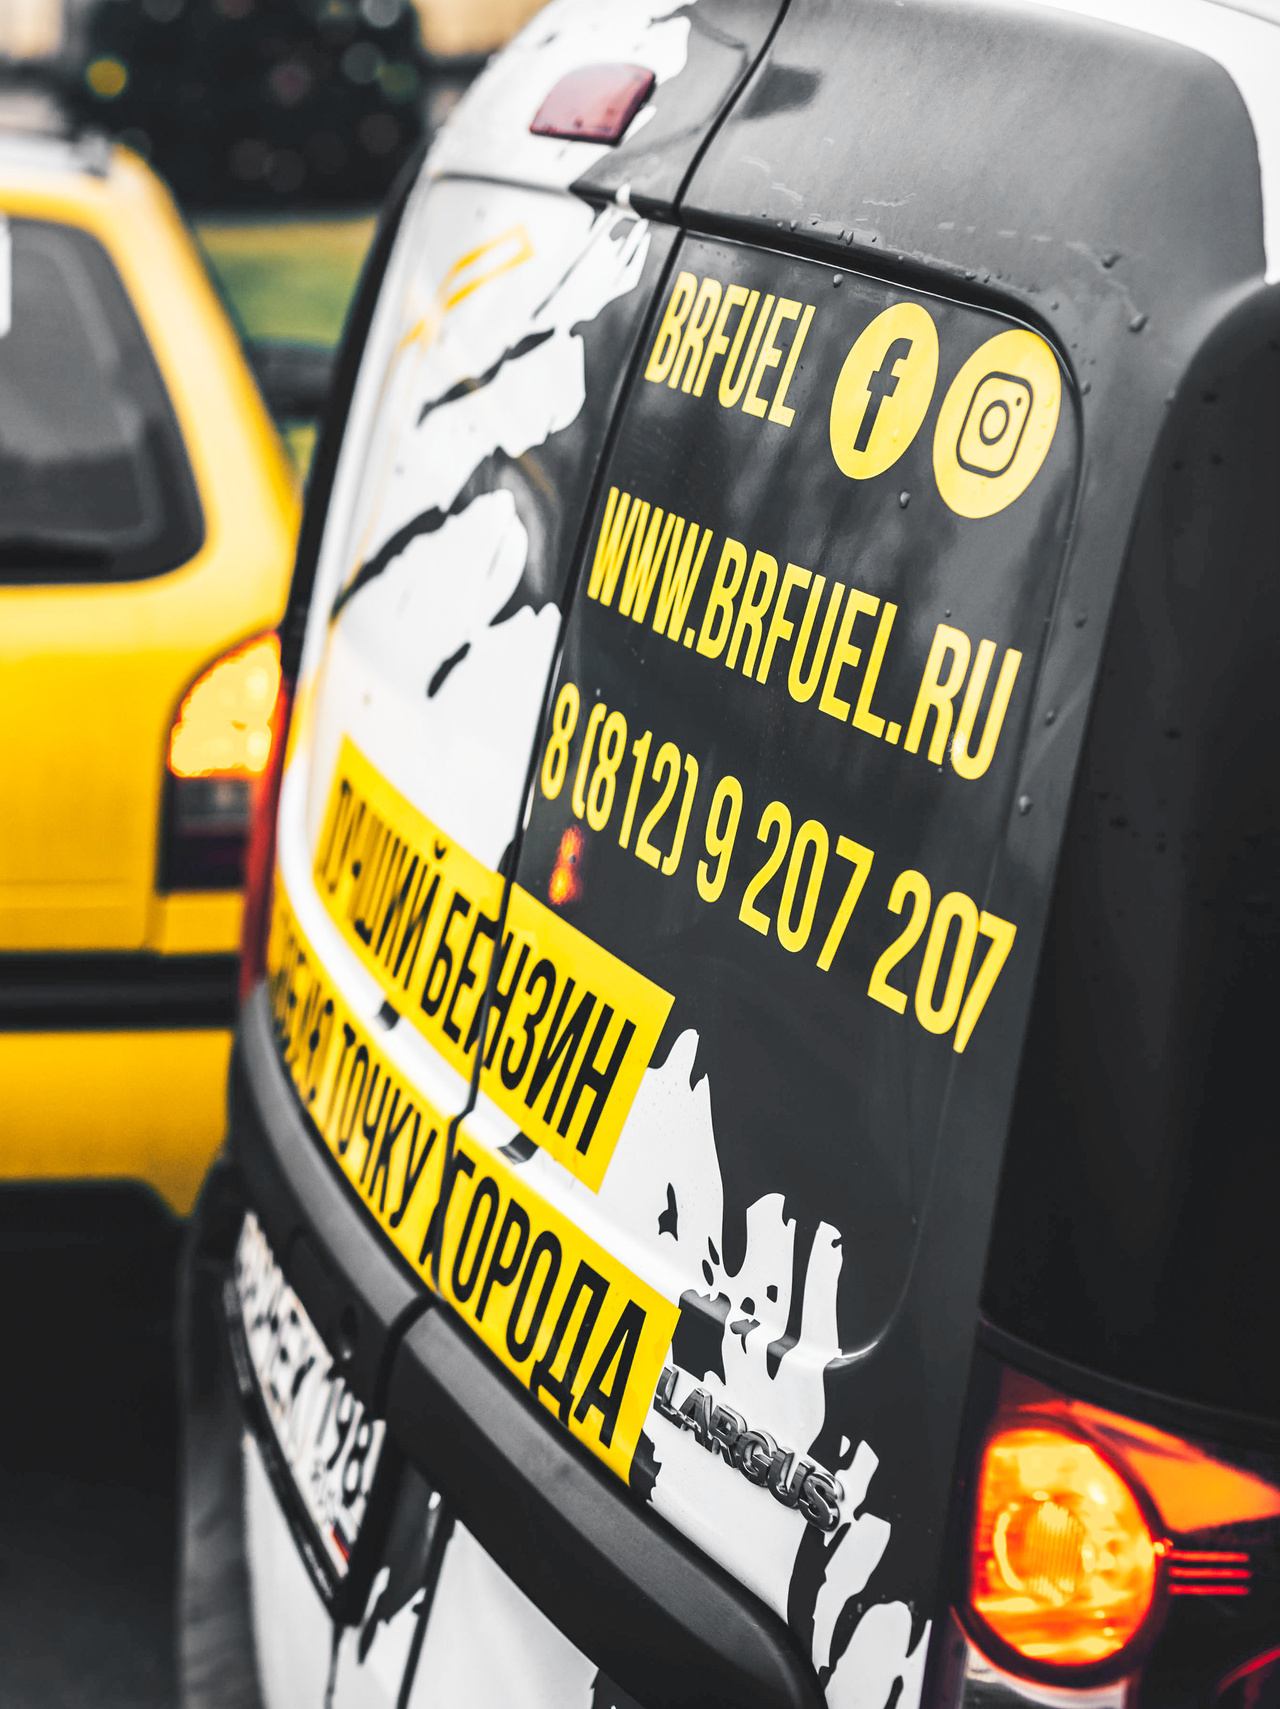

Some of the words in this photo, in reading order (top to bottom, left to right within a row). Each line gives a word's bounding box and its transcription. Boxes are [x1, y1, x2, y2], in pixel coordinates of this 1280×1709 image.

[644, 271, 816, 427] BRFUEL
[587, 486, 1022, 780] WWW.BRFUEL.RU
[541, 682, 580, 800] 8
[572, 702, 699, 876] (812)
[696, 776, 743, 903] 9
[738, 801, 875, 972] 207
[867, 869, 1017, 1053] 207
[421, 891, 637, 1156] БЕНЗИН
[323, 1022, 438, 1229] ТОЧКУ
[419, 1148, 647, 1450] ГОРОДА
[653, 1363, 846, 1533] LARGUS
